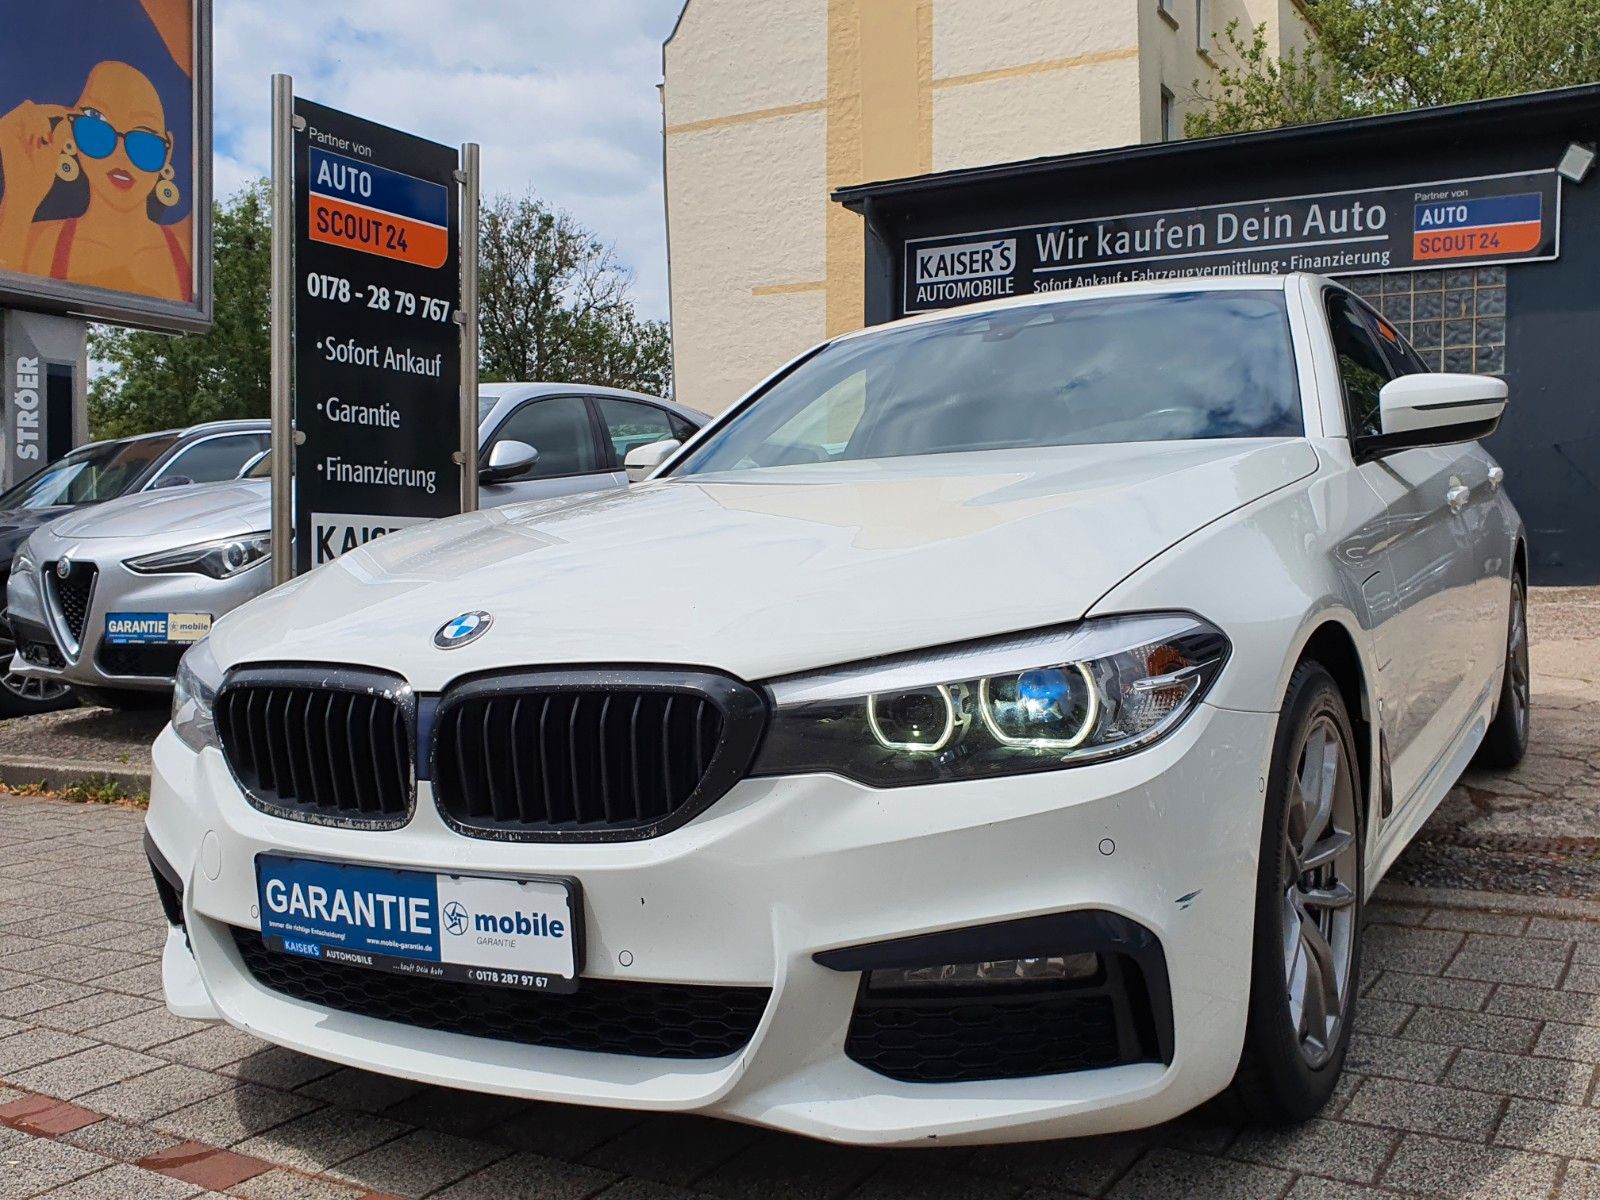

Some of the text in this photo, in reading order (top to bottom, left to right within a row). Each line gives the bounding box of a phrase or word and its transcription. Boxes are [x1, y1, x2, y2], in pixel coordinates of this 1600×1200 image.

[309, 127, 372, 157] Partner von
[317, 159, 372, 198] AUTO
[1414, 188, 1469, 201] Partner von
[1420, 205, 1468, 226] AUTO
[1036, 201, 1387, 262] Wir kaufen Dein Auto
[1033, 278, 1073, 294] Sofort
[1075, 271, 1122, 288] Ankauf
[1290, 249, 1391, 271] Finanzierung
[307, 272, 351, 303] 0178
[367, 284, 390, 311] 28
[394, 290, 416, 316] 79
[420, 296, 450, 322] 767
[917, 277, 1014, 303] AUTOMOBILE
[325, 336, 442, 377] Sofort Ankauf
[14, 356, 39, 460] STRÖER
[326, 397, 401, 428] Garantie
[326, 456, 437, 494] Finanzierung
[108, 620, 167, 633] GARANTIE
[180, 623, 209, 631] mobile
[266, 878, 432, 935] GARANTIE
[475, 911, 565, 938] mobile
[326, 949, 373, 965] AUTOMOBILE
[476, 937, 516, 948] GARANTIE
[475, 970, 548, 988] 0178 287 97 67
